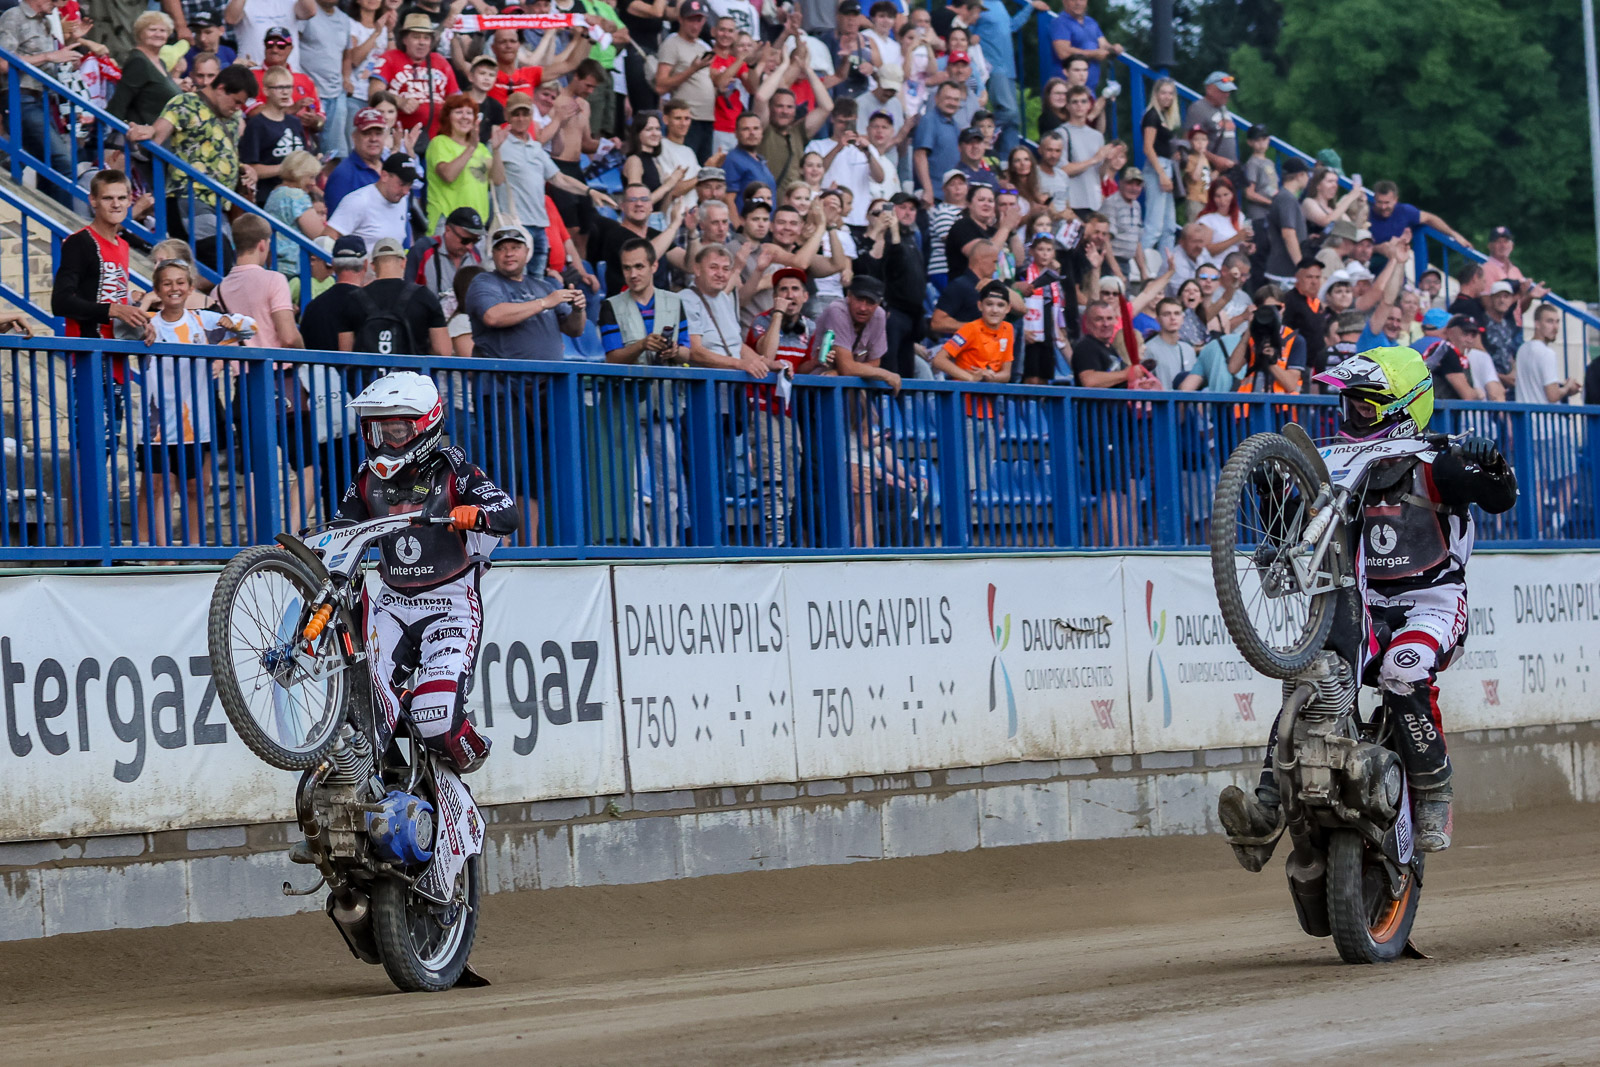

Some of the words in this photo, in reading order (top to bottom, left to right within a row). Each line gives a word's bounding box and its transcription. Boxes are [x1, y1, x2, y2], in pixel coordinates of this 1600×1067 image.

[101, 262, 116, 304] XING
[1394, 421, 1414, 436] Arai
[1333, 444, 1392, 455] Intergaz
[333, 525, 385, 540] Intergaz
[390, 565, 435, 577] Intergaz
[1365, 555, 1410, 568] Intergaz
[396, 596, 453, 606] TICKETKOSTA
[1513, 583, 1600, 624] DAUGAVPIL
[625, 602, 783, 656] DAUGAVPILS
[807, 595, 953, 650] DAUGAVPILS
[1022, 616, 1111, 651] DAUGAVPILS
[1468, 607, 1495, 636] VPILS
[1081, 665, 1114, 688] CENTRS
[1518, 653, 1546, 694] 750
[631, 695, 677, 749] 750
[812, 686, 854, 738] 750
[1417, 713, 1437, 741] ZOO
